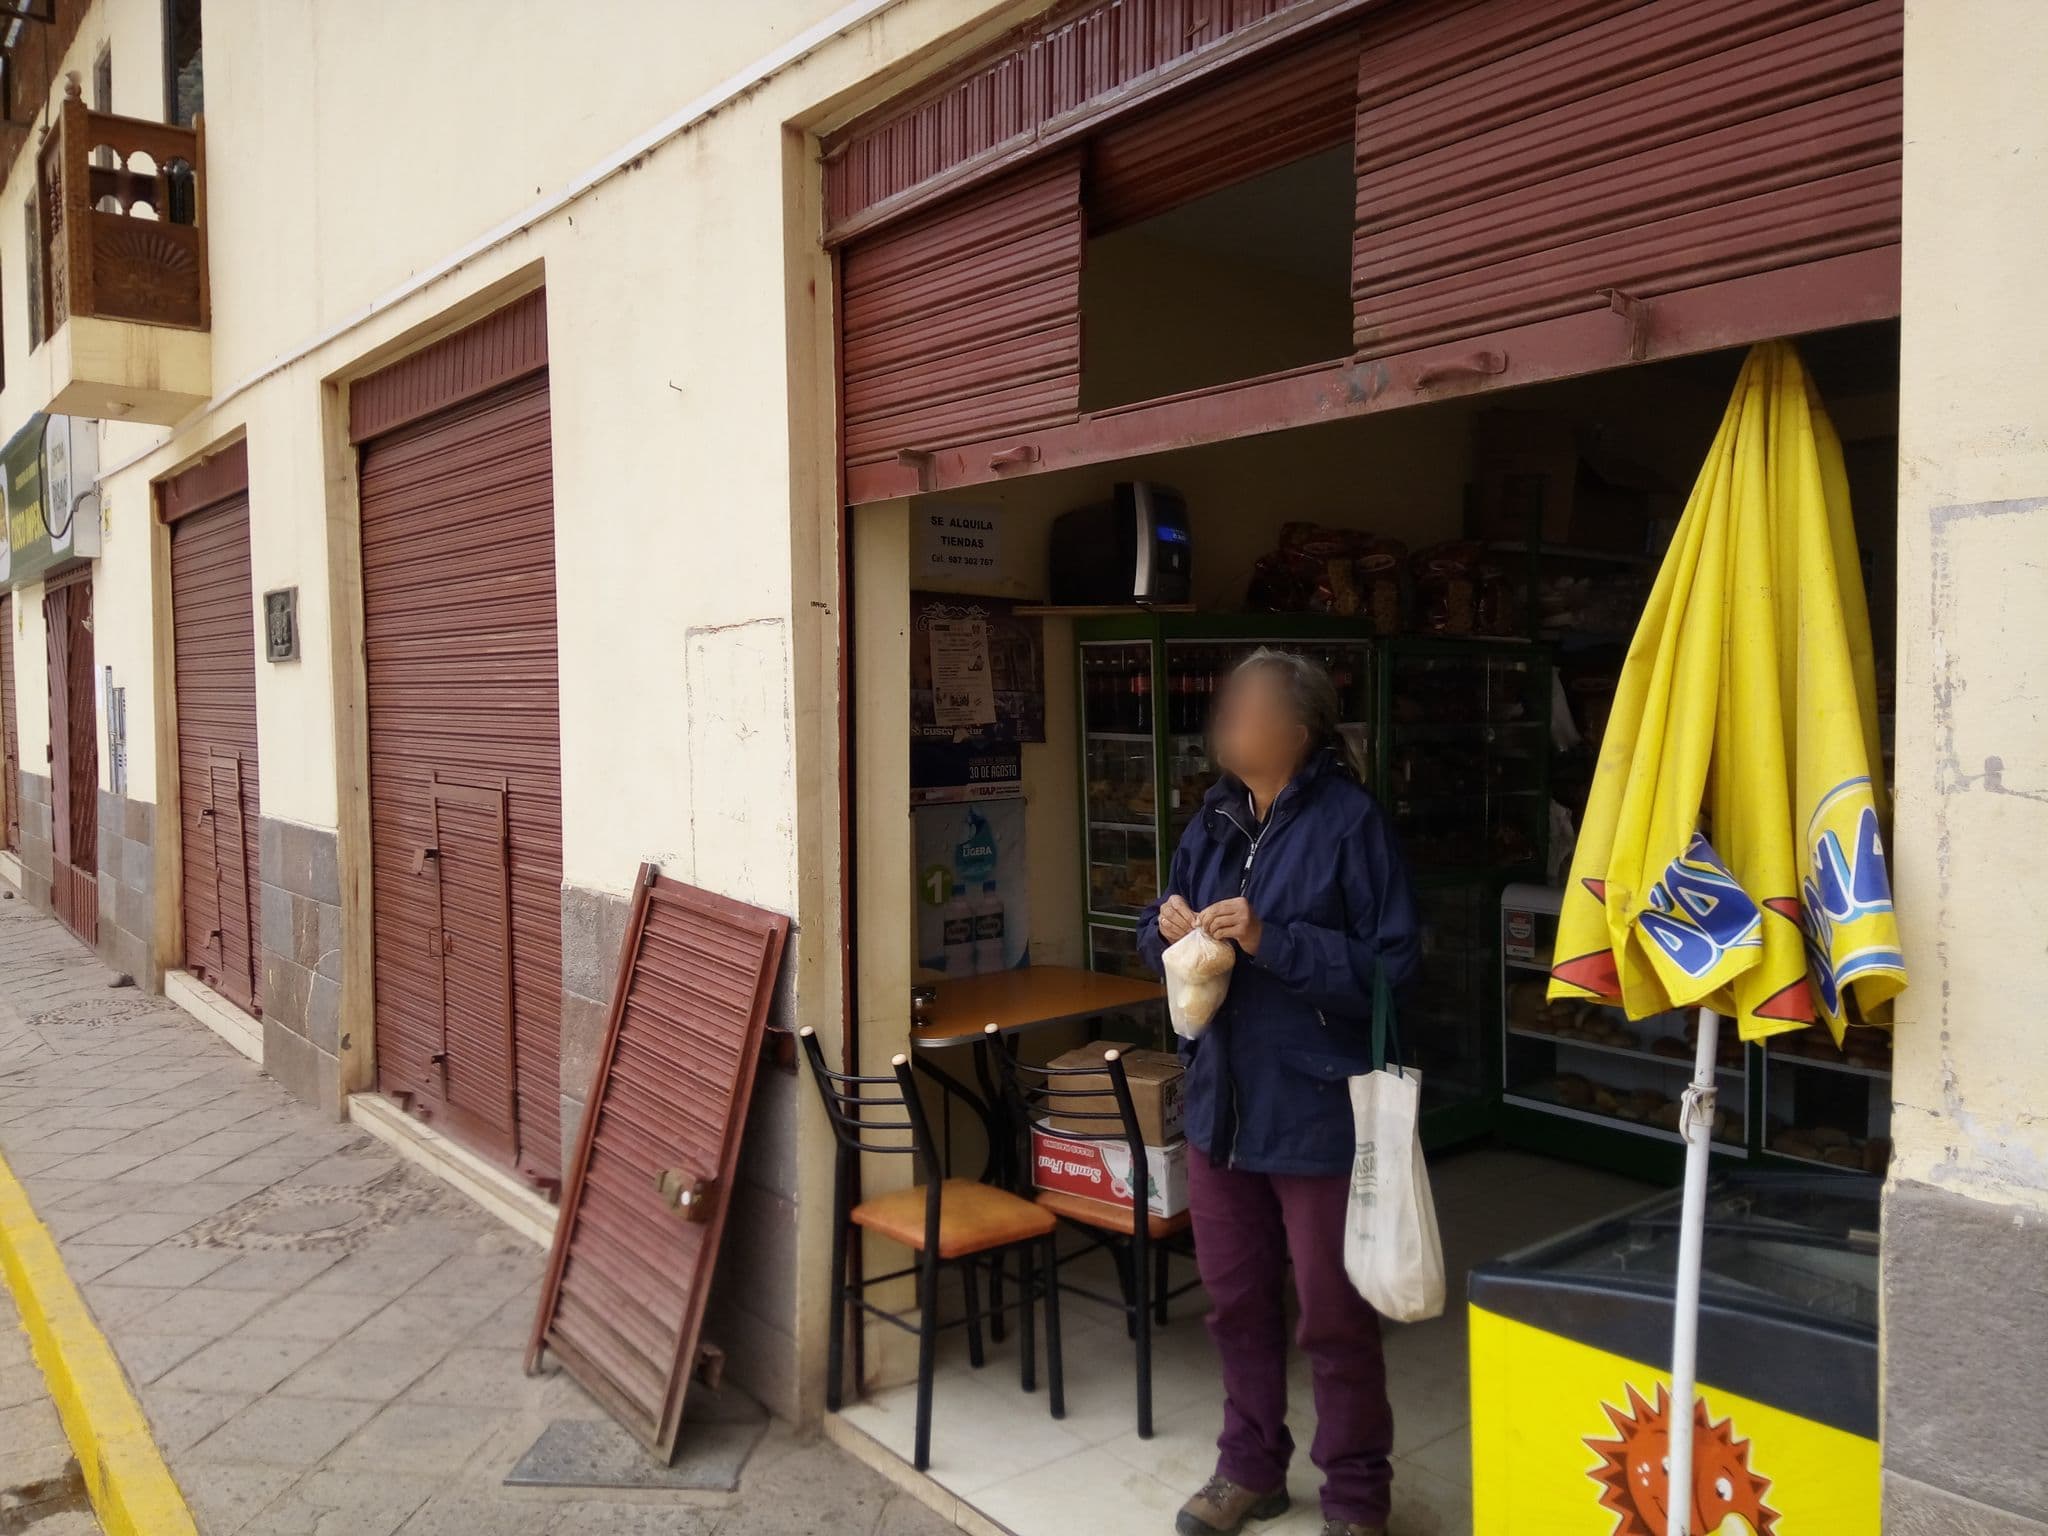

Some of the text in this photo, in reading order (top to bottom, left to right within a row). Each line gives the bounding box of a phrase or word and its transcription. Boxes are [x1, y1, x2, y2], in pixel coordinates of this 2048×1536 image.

[931, 516, 993, 530] SE ALQUILA
[941, 536, 984, 548] TIENDAS
[981, 766, 990, 778] DE
[991, 765, 1017, 779] AGOSTO
[962, 846, 993, 857] LIGERA
